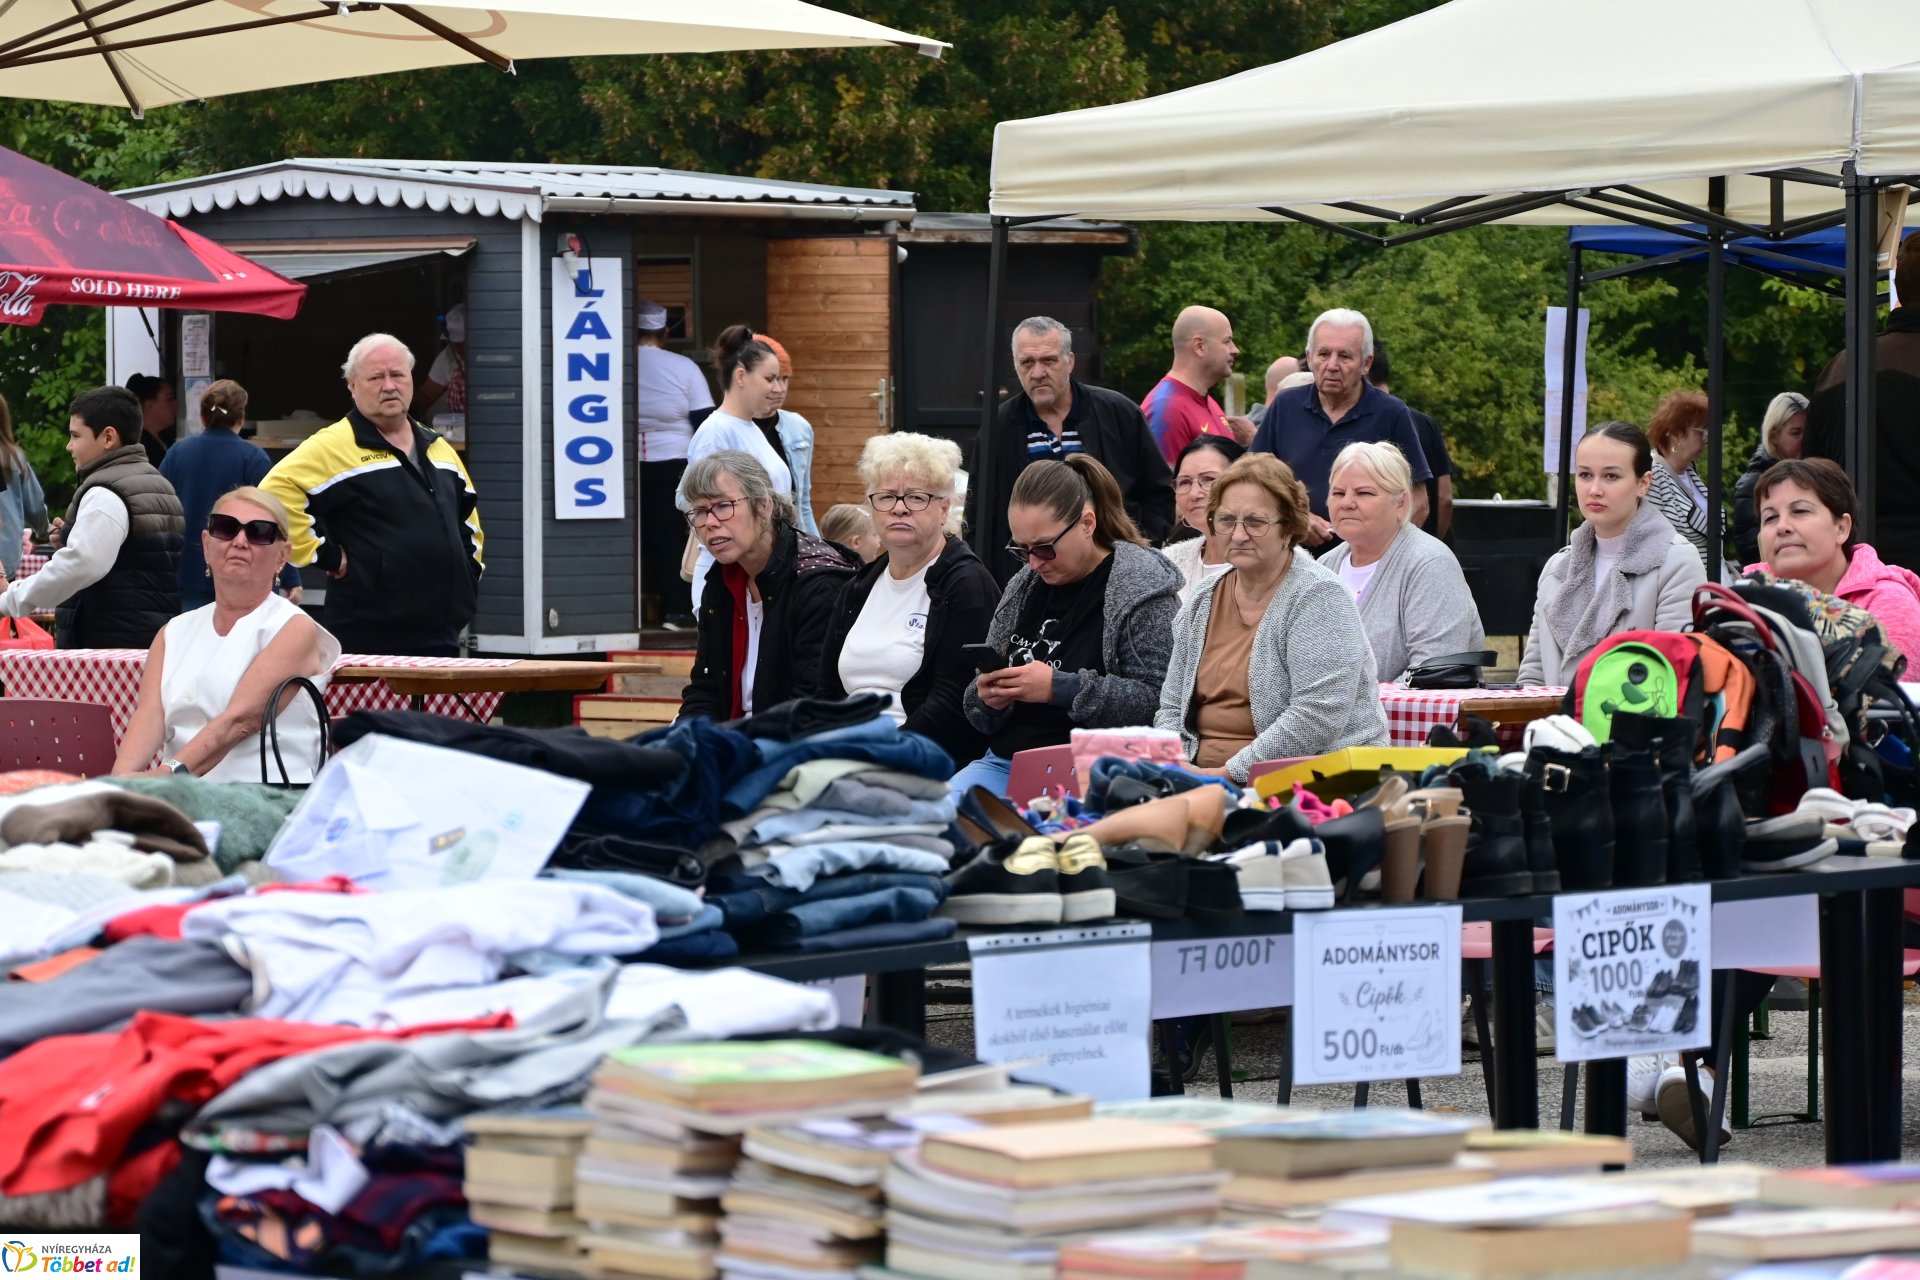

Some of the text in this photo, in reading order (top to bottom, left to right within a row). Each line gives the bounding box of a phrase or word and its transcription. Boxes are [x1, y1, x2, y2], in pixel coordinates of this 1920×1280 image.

[70, 276, 182, 300] SOLD HERE
[564, 268, 614, 507] LÁNGOS
[1322, 940, 1441, 966] ADOMÁNYSOR
[1582, 921, 1656, 960] CIPŐK
[1589, 958, 1644, 994] 1000
[1356, 980, 1407, 1013] Cipők
[1323, 1028, 1379, 1062] 500
